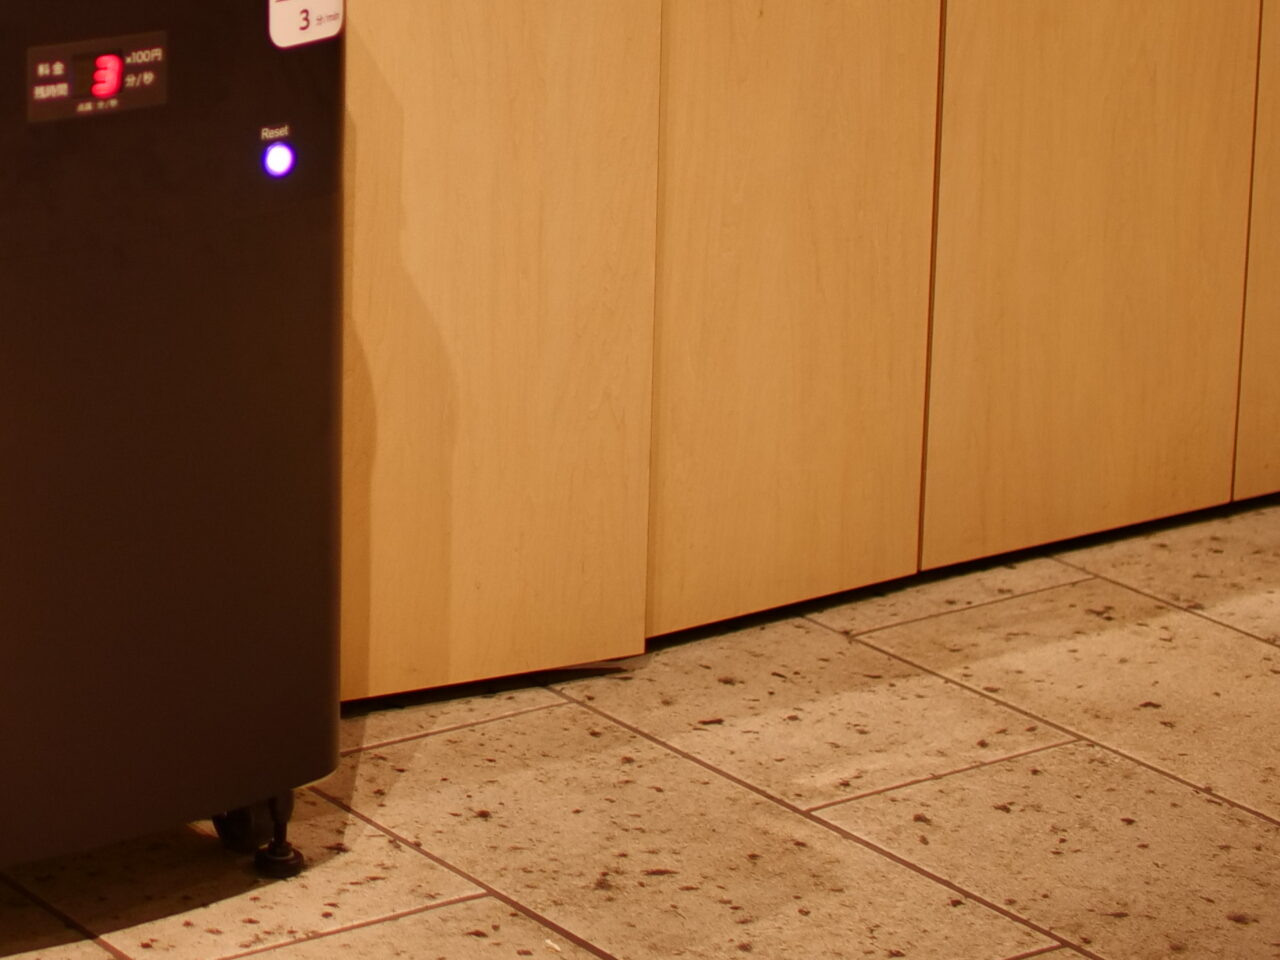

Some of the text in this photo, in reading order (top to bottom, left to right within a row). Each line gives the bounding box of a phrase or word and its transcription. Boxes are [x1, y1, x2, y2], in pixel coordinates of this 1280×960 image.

[298, 8, 311, 31] 3
[91, 53, 124, 98] 3
[260, 124, 289, 141] Reset
